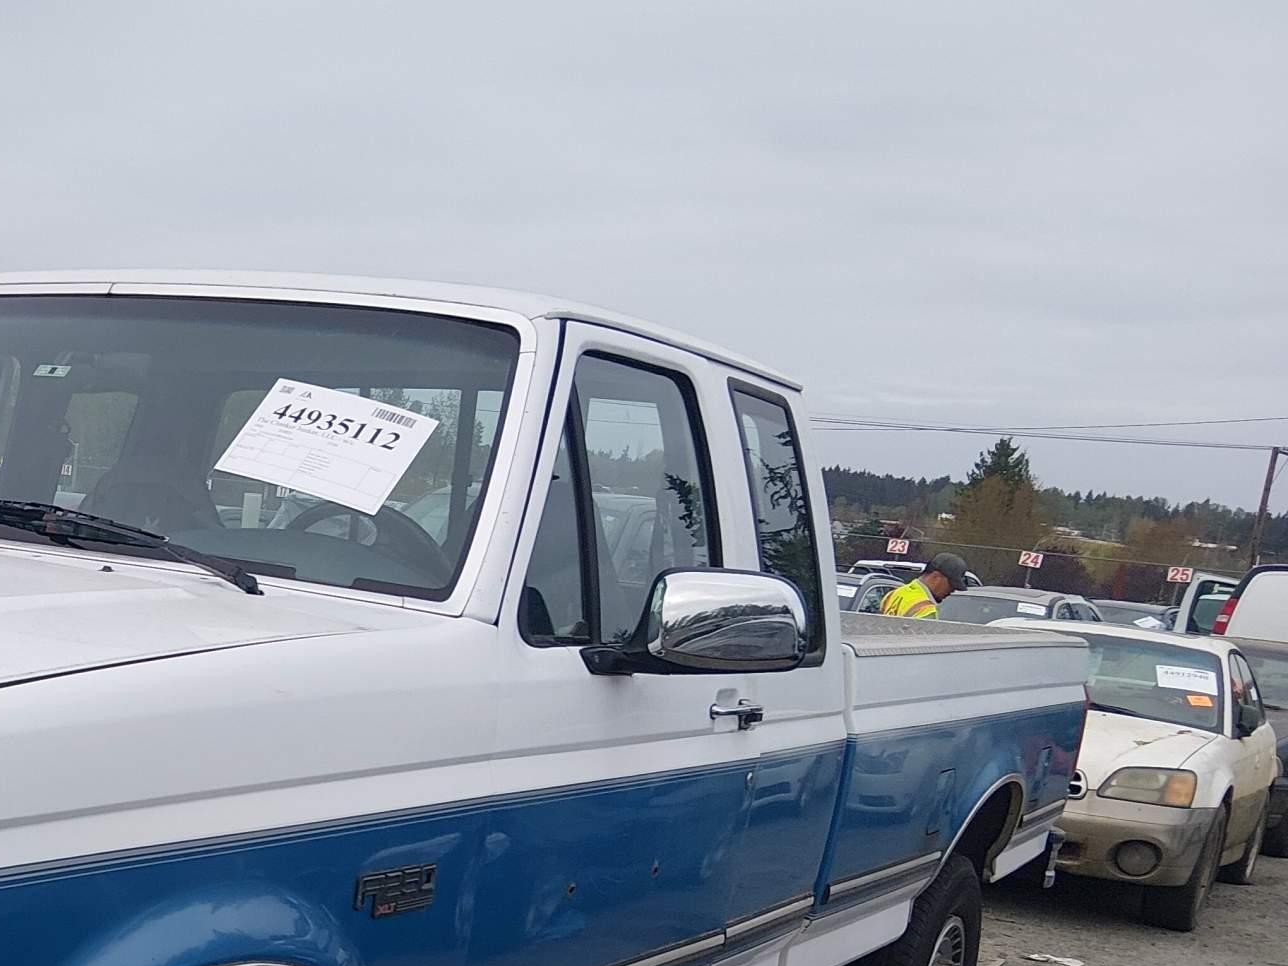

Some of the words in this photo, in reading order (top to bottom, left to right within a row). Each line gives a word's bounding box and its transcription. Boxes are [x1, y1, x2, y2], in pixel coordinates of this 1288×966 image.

[273, 403, 401, 450] 44935112
[889, 540, 906, 553] 23
[1021, 552, 1040, 566] 24
[1169, 567, 1190, 581] 25
[375, 902, 396, 917] XLT
